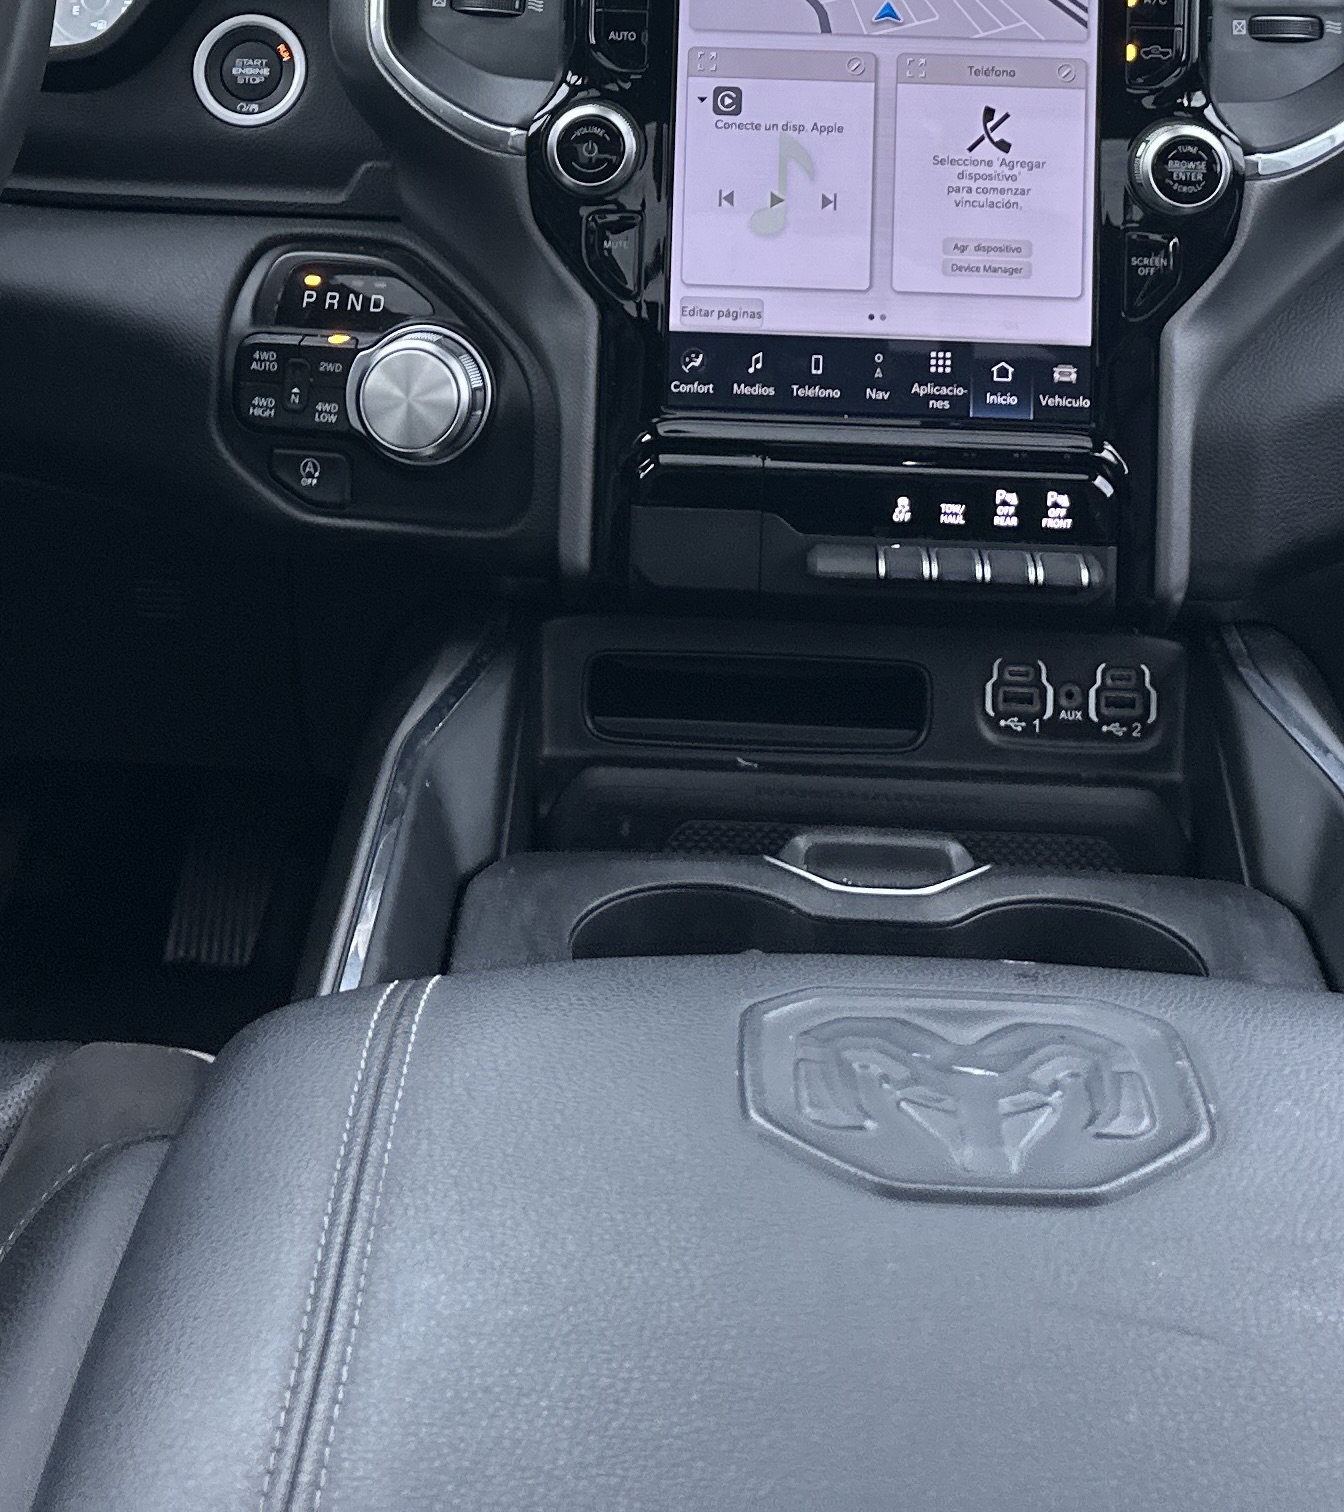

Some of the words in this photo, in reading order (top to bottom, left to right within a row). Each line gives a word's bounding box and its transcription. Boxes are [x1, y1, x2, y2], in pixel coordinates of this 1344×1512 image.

[608, 31, 637, 42] AUTO
[235, 58, 269, 68] START
[232, 67, 271, 76] ENGINE
[968, 65, 1016, 78] Teléfono
[237, 76, 265, 85] STOP
[574, 125, 606, 137] VOLUME
[714, 119, 762, 132] Conecte
[764, 123, 779, 133] un
[810, 122, 844, 136] Apple
[1177, 144, 1199, 154] TUNE
[932, 154, 994, 168] Seleccione
[1168, 159, 1207, 170] BROWSE
[1172, 172, 1204, 181] ENTER
[947, 185, 973, 196] para
[975, 186, 1032, 197] comenzar
[1172, 183, 1203, 194] SCROLL
[974, 242, 1023, 255] dispositivo
[1131, 256, 1168, 267] SCREEN
[951, 263, 981, 274] Device
[983, 264, 1023, 276] Manager
[1137, 267, 1156, 276] OFF
[302, 291, 317, 308] P
[325, 292, 340, 310] R
[347, 293, 363, 312] N
[369, 295, 385, 313] D
[681, 305, 715, 318] Editar
[717, 307, 762, 322] páginas
[253, 350, 277, 361] 4WD
[250, 360, 278, 372] AUTO
[319, 362, 343, 373] 2WD
[670, 380, 714, 394] Confort
[733, 382, 775, 396] Medios
[791, 384, 841, 399] Teléfono
[911, 382, 968, 397] Aplicacio-
[290, 394, 300, 405] N
[866, 387, 891, 400] Nav
[986, 392, 1018, 405] Inicio
[251, 396, 276, 407] 4WD
[928, 399, 950, 410] nes
[1039, 394, 1091, 408] Vehículo
[249, 406, 275, 418] HIGH
[315, 402, 339, 413] 4WD
[314, 412, 338, 424] LOW
[300, 477, 318, 486] OFF
[892, 511, 912, 522] OFF
[996, 505, 1016, 516] OFF
[1047, 507, 1067, 518] OFF
[939, 513, 966, 525] HAUL
[993, 515, 1018, 527] REAR
[1041, 517, 1073, 529] FRONT
[1059, 709, 1083, 721] AUX
[1032, 718, 1040, 733] 1
[1131, 722, 1142, 737] 2
